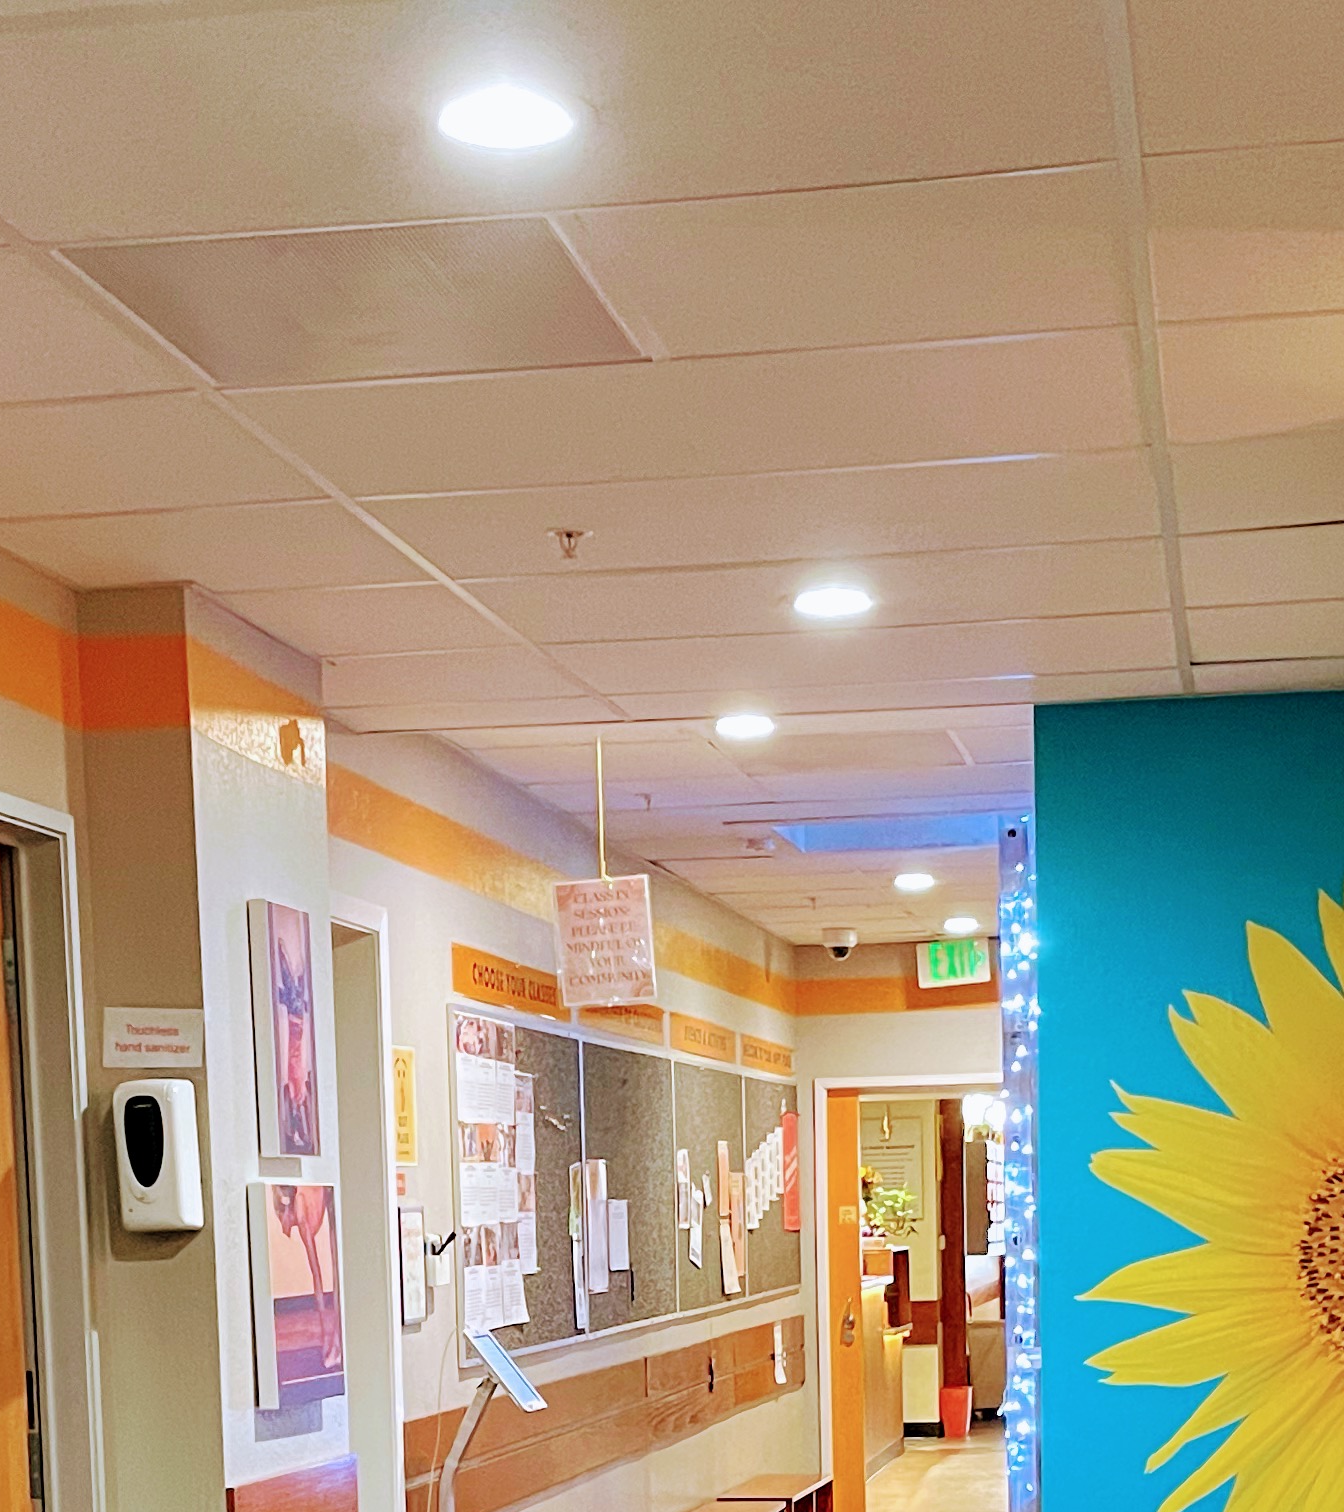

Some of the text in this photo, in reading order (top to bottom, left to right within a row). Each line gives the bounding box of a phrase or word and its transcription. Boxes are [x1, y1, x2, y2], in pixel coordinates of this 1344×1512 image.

[928, 938, 977, 980] EXIT
[472, 962, 505, 993] CHOOSE
[126, 1024, 179, 1037] Touchless
[115, 1041, 191, 1054] hand sanitizer
